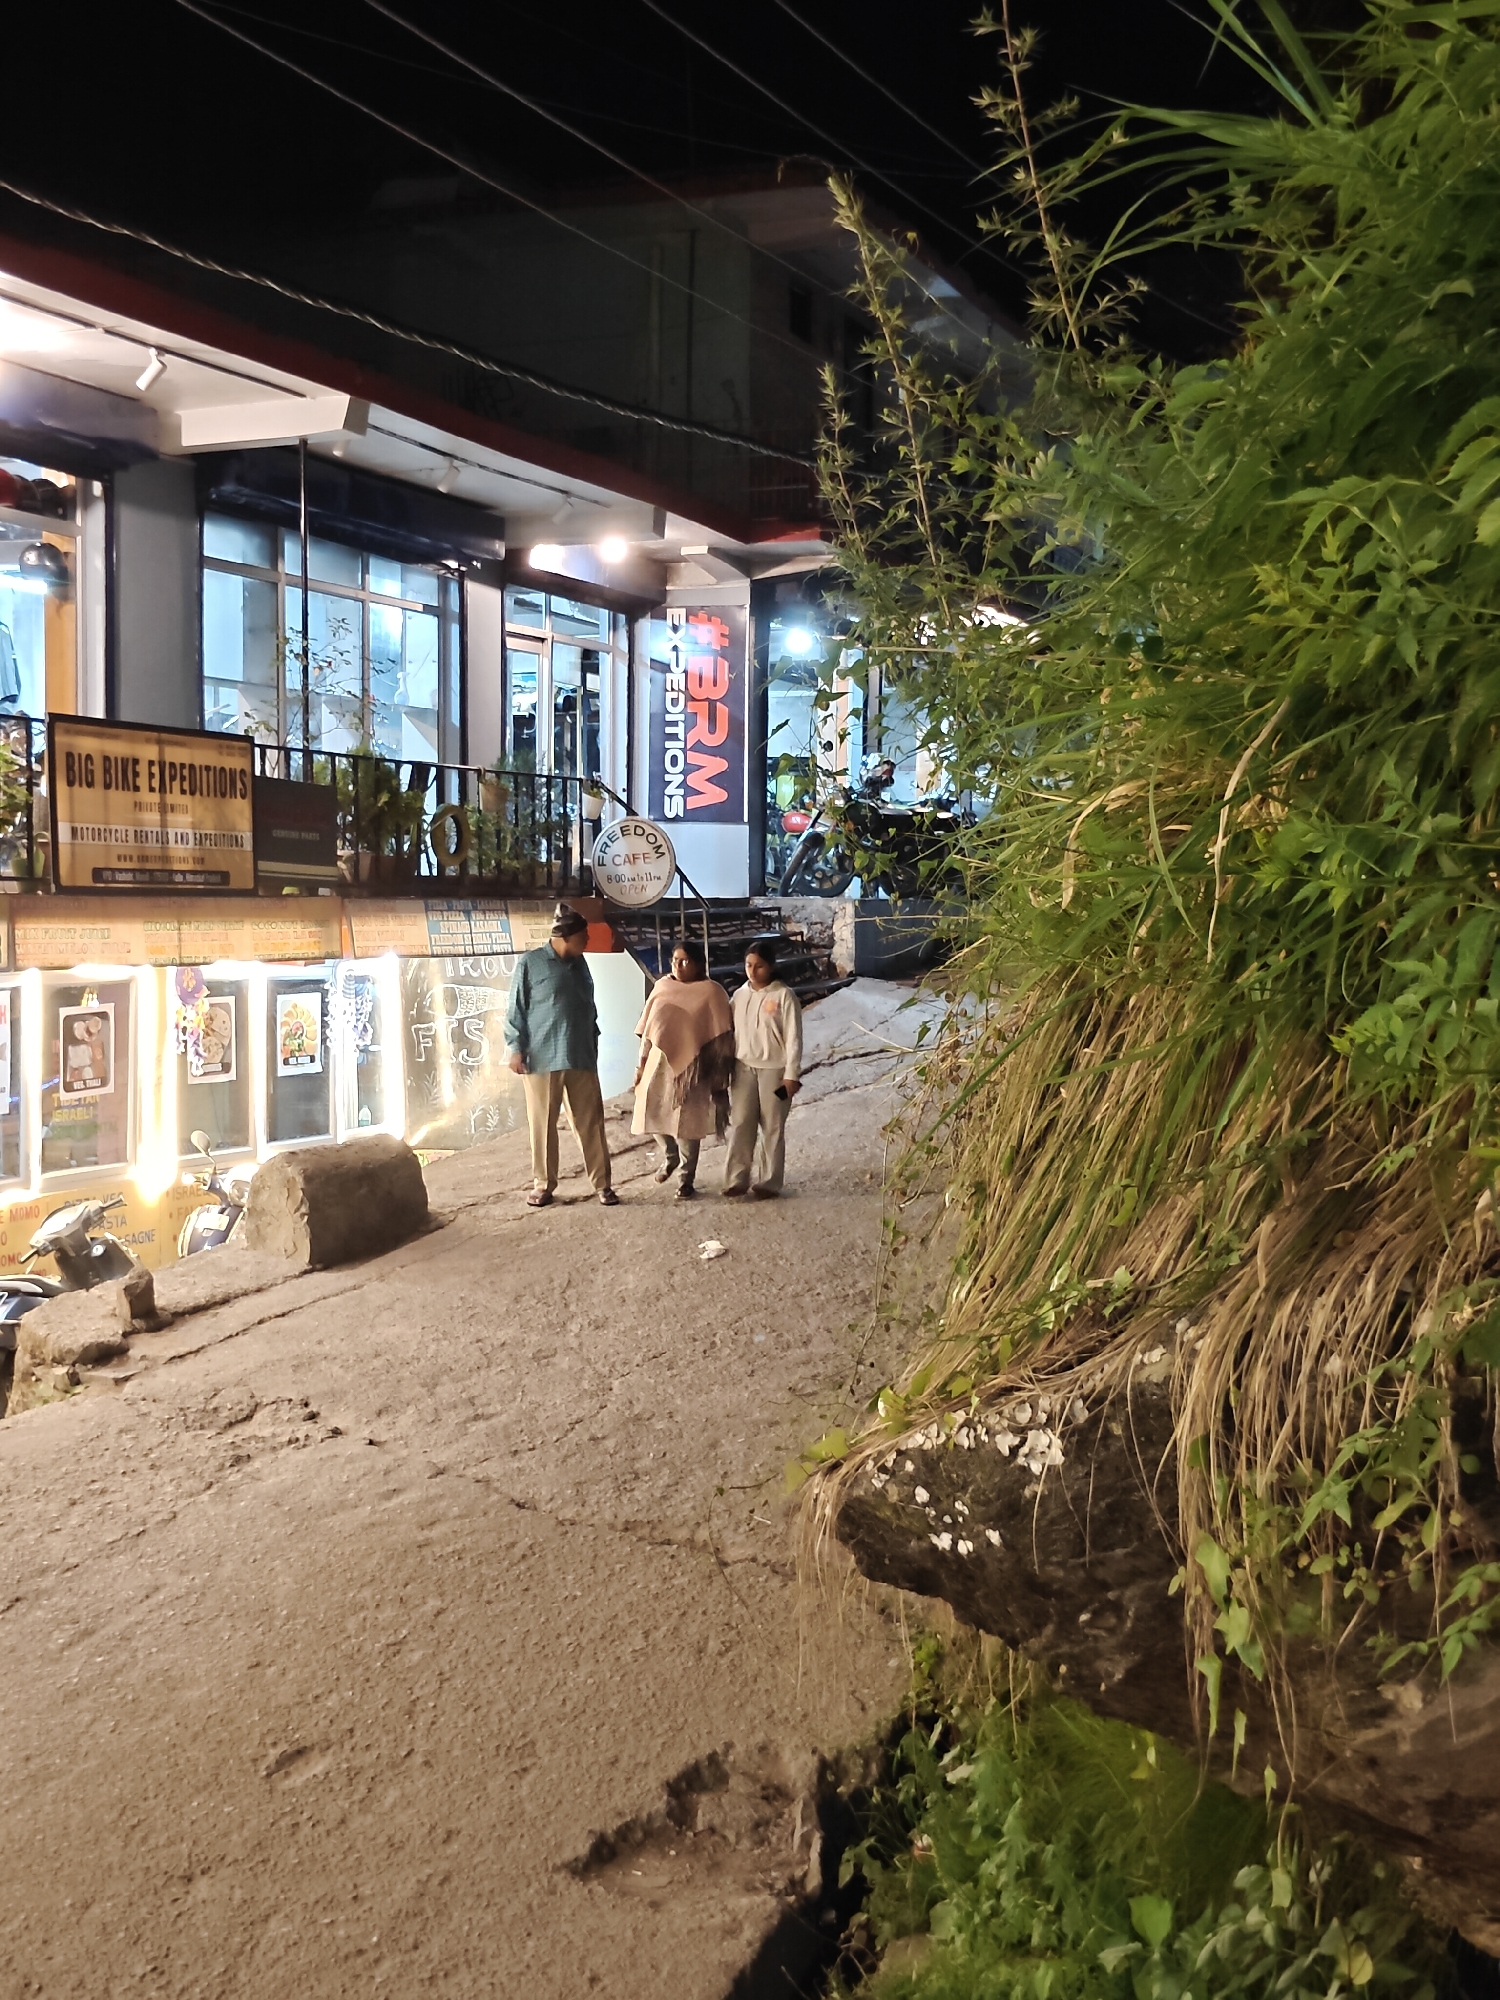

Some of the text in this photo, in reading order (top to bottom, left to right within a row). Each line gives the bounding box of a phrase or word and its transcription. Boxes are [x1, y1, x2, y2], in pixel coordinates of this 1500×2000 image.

[664, 607, 687, 820] EXPEDITIONS
[65, 751, 248, 800] BIG BIKE EXPEDITIONS
[134, 801, 161, 814] PRIVATE
[71, 825, 245, 849] MOTORCYCLE RENTALS AND EXPEDITIONS
[301, 831, 320, 841] PARTS
[597, 824, 666, 867] FREEDOM
[612, 852, 652, 867] CAFE
[620, 884, 648, 896] OPEN
[485, 910, 508, 920] PASTA
[15, 928, 111, 940] MIX FRUIT JUICE
[444, 957, 518, 979] TROU
[411, 1018, 510, 1066] FIS
[10, 1205, 41, 1222] MOMO
[98, 1214, 128, 1230] ASTA
[118, 1228, 157, 1247] SAGNE
